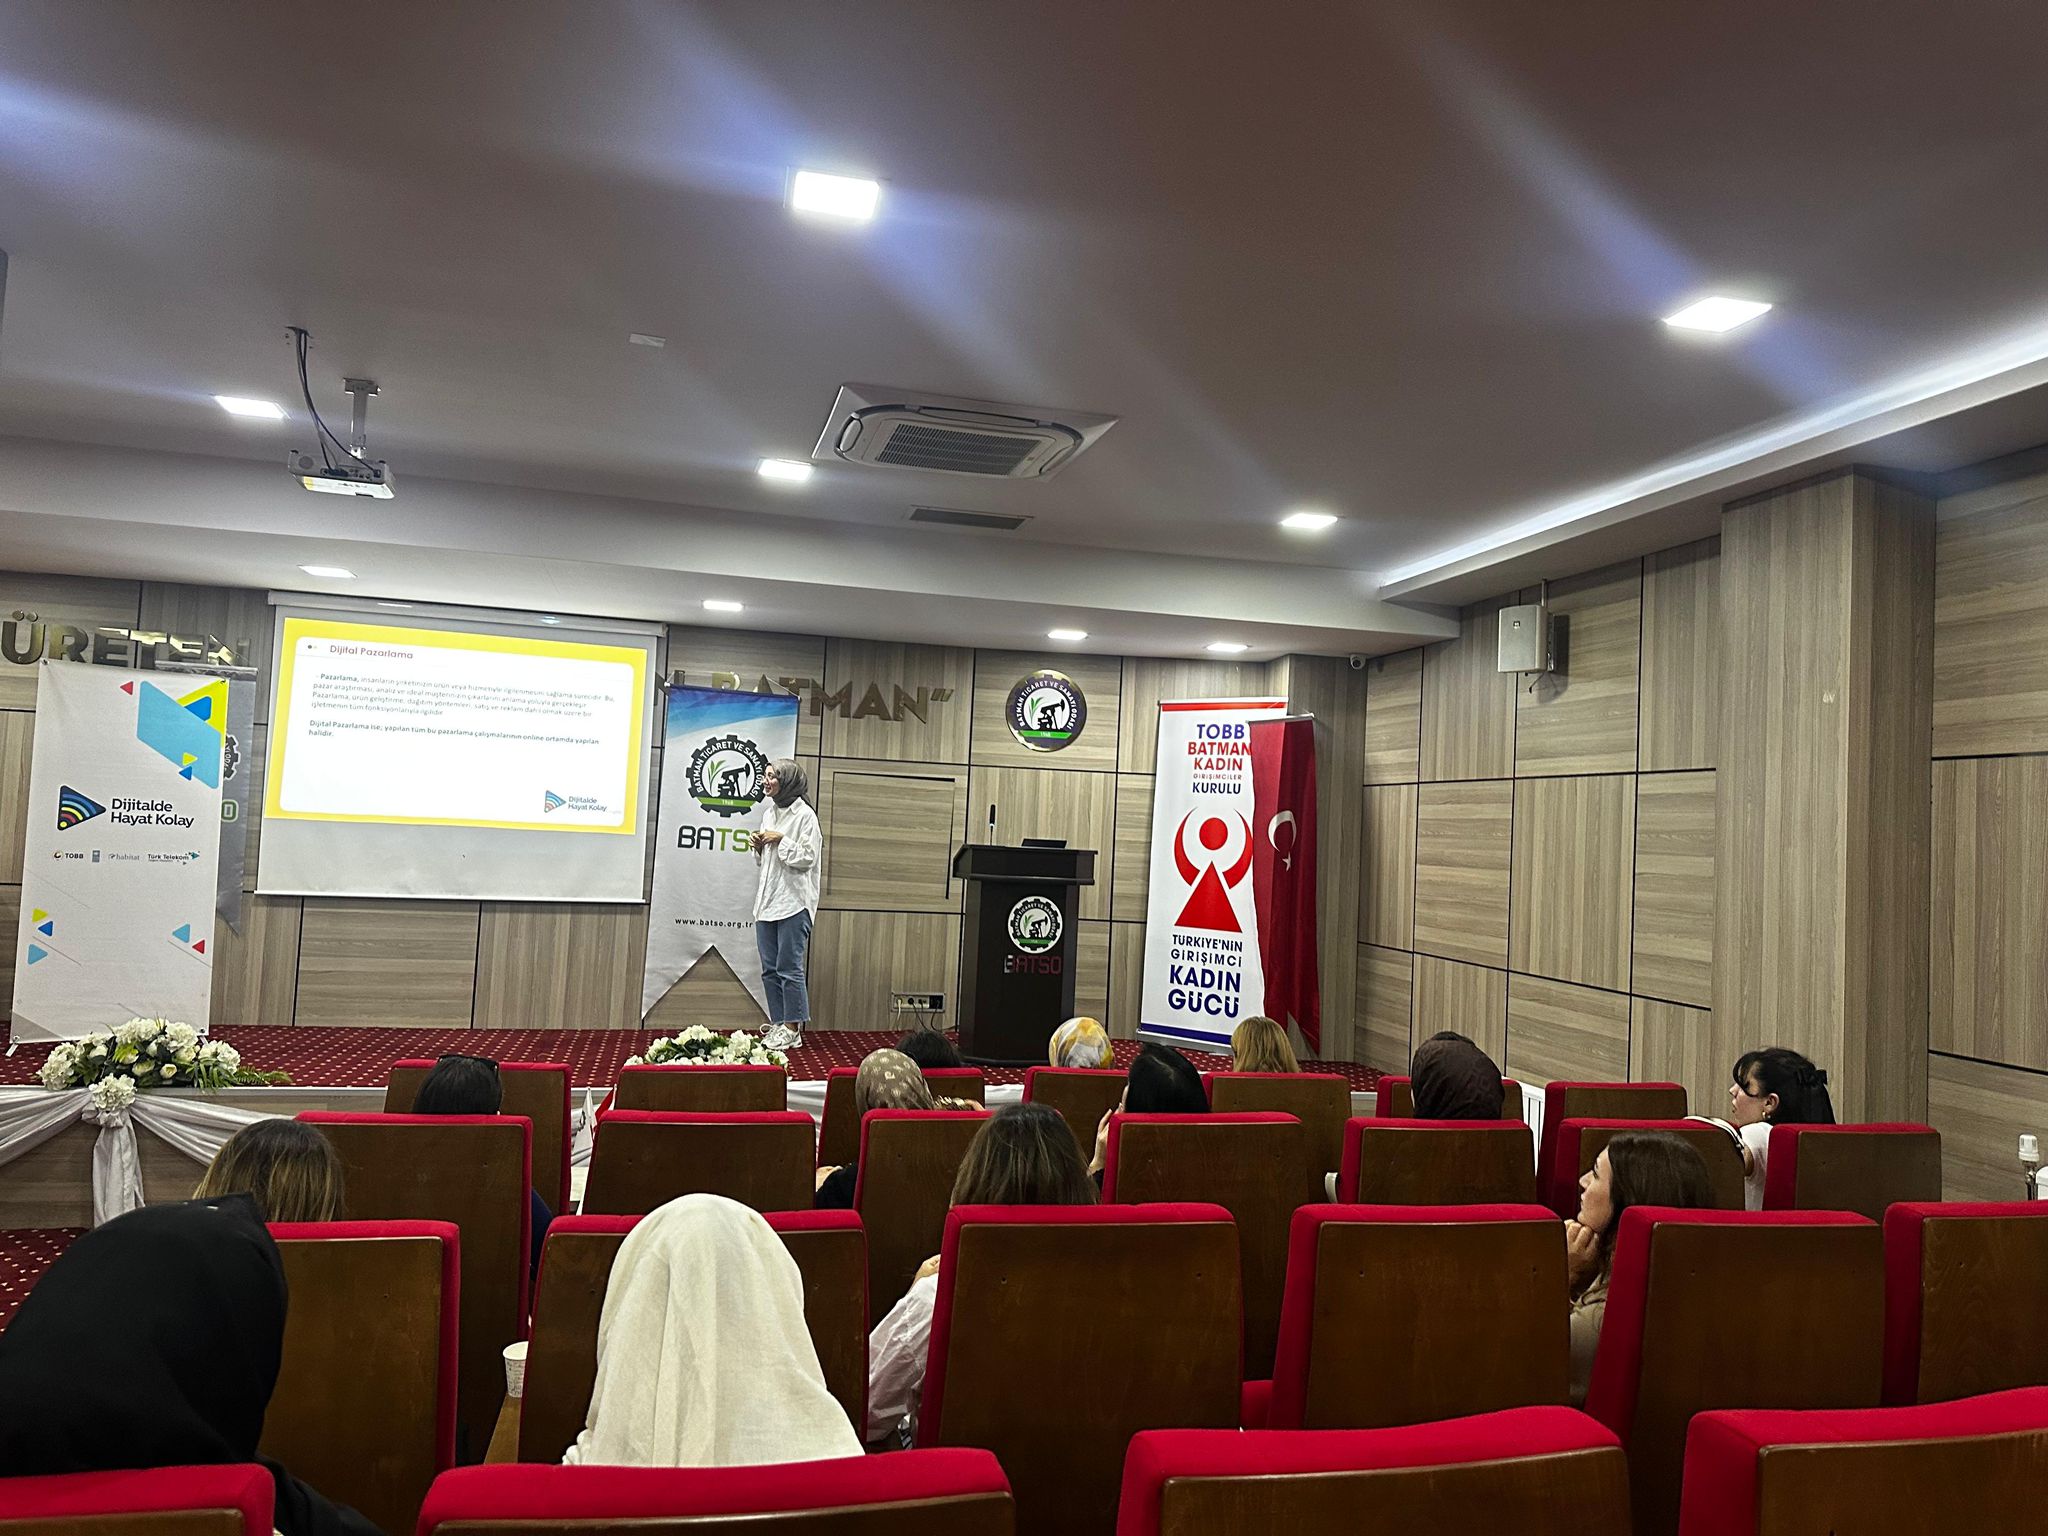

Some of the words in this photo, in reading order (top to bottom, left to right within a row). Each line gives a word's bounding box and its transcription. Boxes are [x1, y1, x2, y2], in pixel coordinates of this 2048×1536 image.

[360, 648, 414, 659] Pazarlama
[333, 721, 370, 730] Pazarlama
[438, 729, 474, 737] pazarlama
[546, 736, 574, 744] ortamda
[1197, 724, 1244, 739] TOBB
[1188, 742, 1252, 756] BATMAN
[693, 758, 704, 793] BATMAN
[734, 742, 744, 752] VE
[1194, 757, 1243, 771] KADIN
[1192, 782, 1241, 794] KURULU
[111, 798, 173, 812] Dijitalde
[568, 796, 598, 804] Dijitalde
[568, 804, 588, 812] Hayat
[589, 804, 608, 812] Kolay
[110, 812, 152, 826] Hayat
[155, 813, 194, 828] Kolay
[677, 825, 754, 853] BATS
[675, 918, 754, 929] www.batso.org.tr
[1172, 934, 1243, 952] TÜRKİYE'NİN
[1004, 954, 1062, 974] BATSO
[1170, 964, 1241, 993] KADIN
[1168, 988, 1239, 1018] GÜCÜ
